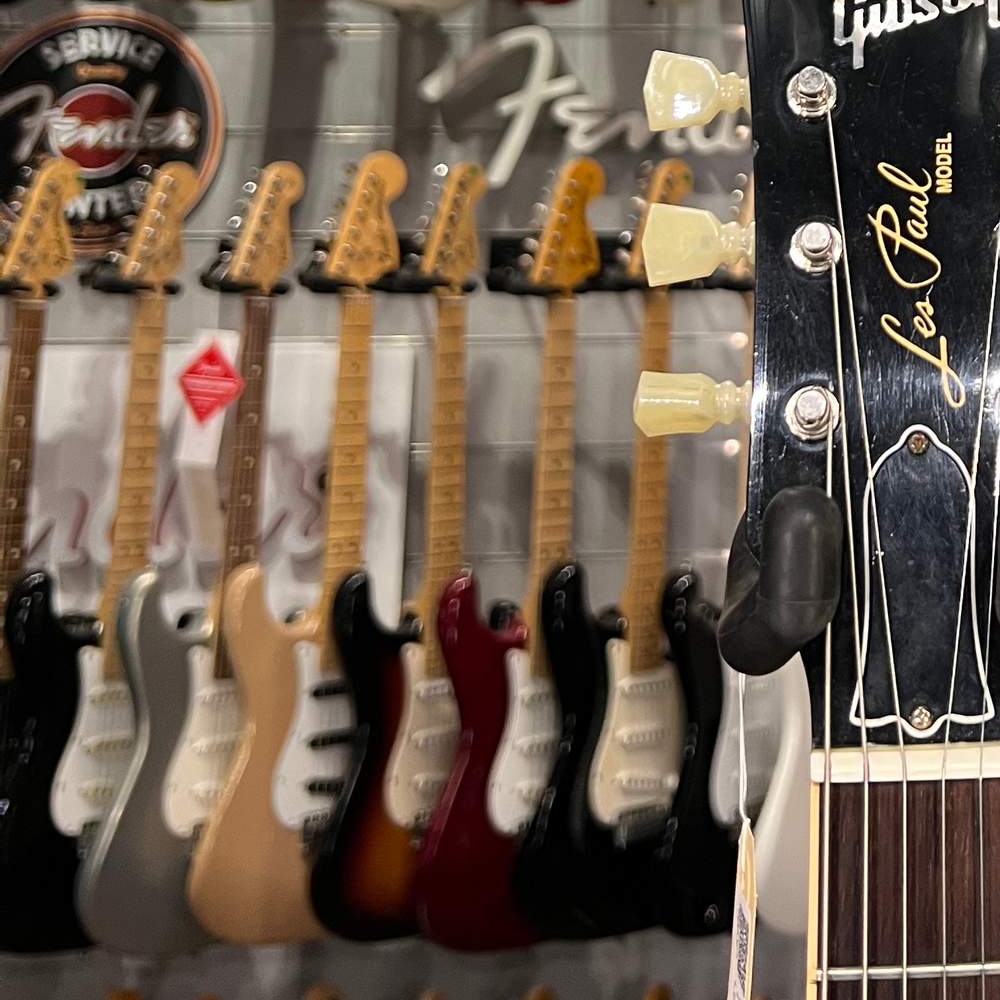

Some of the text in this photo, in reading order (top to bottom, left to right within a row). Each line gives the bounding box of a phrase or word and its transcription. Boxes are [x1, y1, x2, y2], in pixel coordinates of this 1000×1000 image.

[40, 26, 164, 72] SERVICE
[934, 131, 953, 194] MODEL
[867, 162, 966, 408] Les Paul
